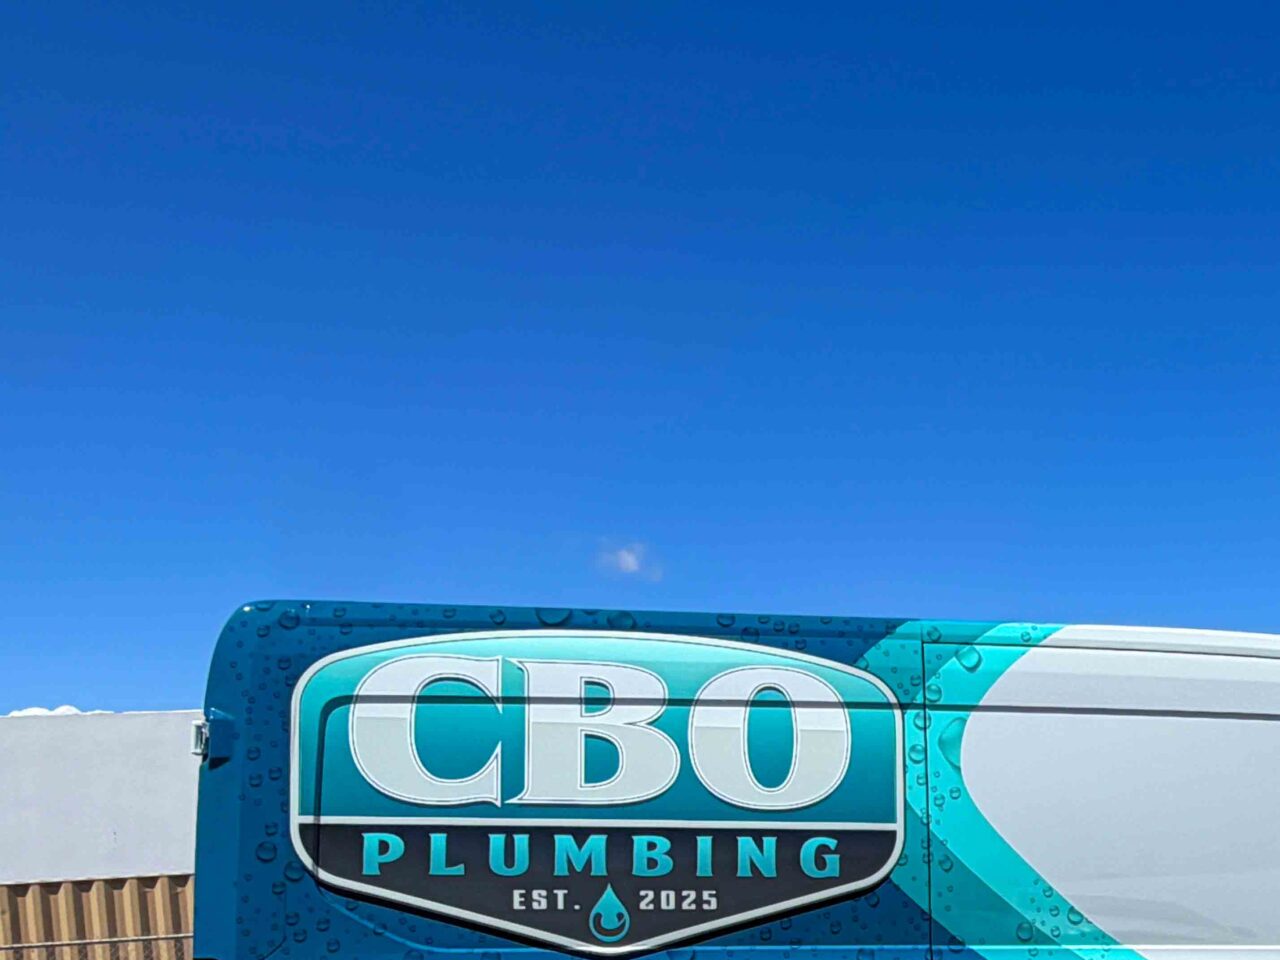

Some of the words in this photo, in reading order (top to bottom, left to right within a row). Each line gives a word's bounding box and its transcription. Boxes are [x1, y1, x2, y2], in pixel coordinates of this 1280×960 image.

[349, 654, 851, 811] CBO
[361, 832, 841, 878] PLUMBING
[513, 889, 581, 910] EST.
[639, 890, 717, 910] 2025
